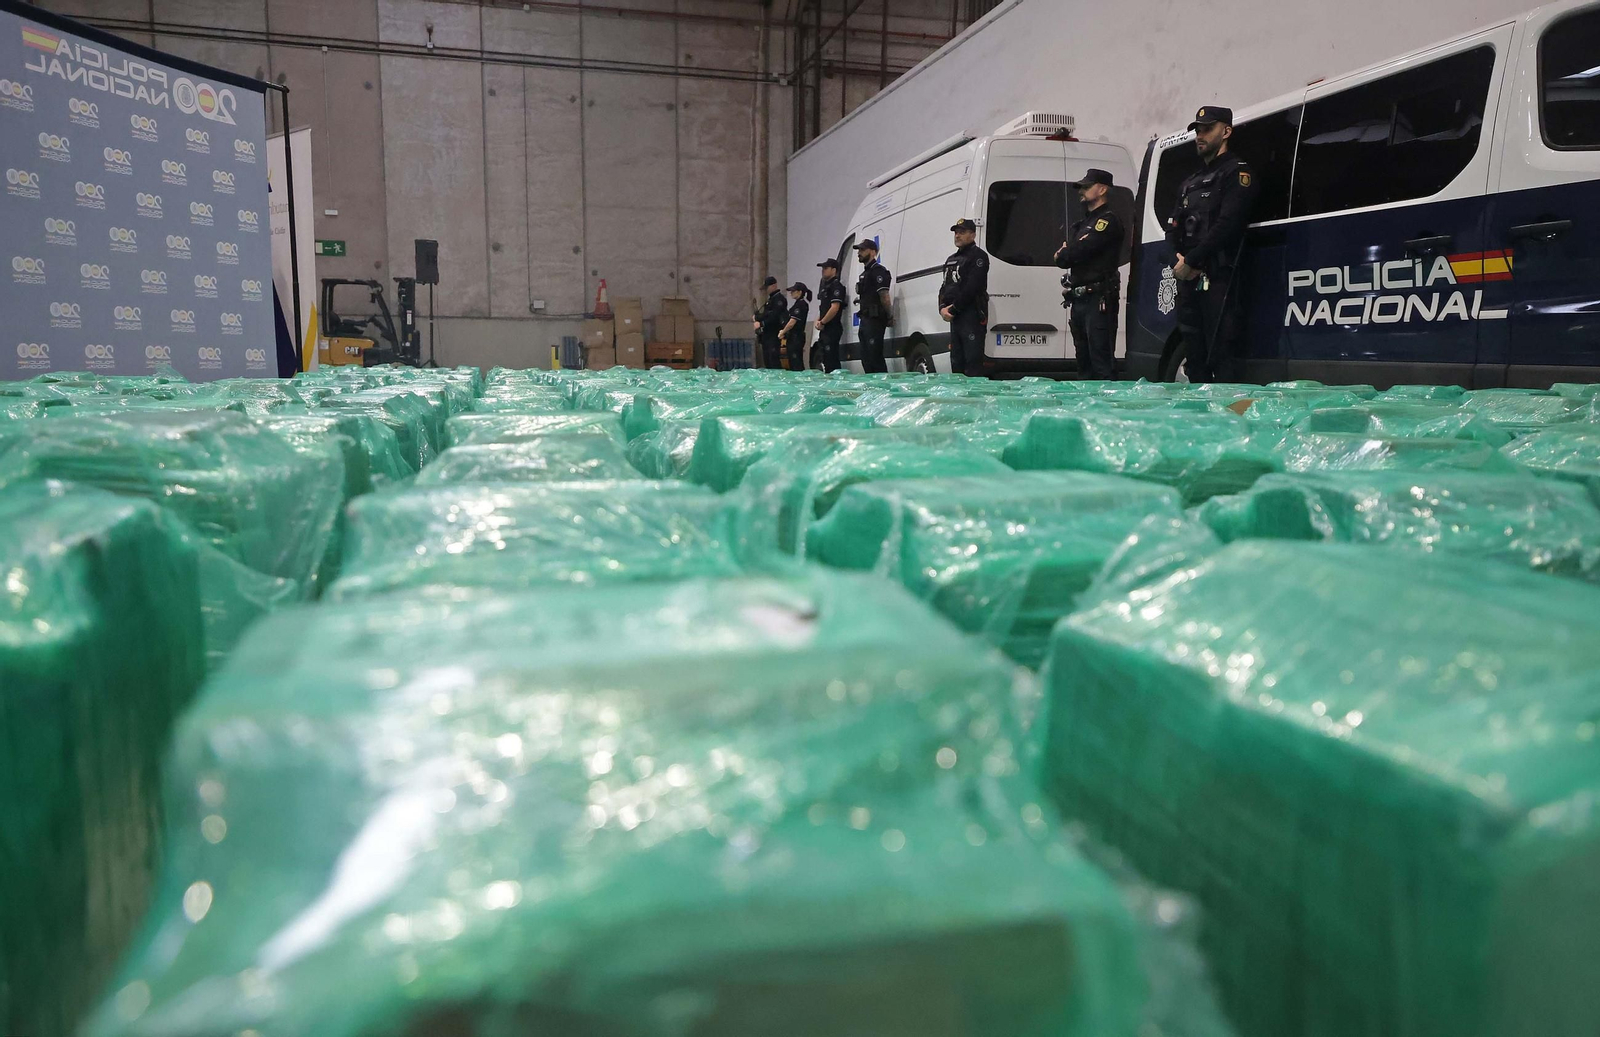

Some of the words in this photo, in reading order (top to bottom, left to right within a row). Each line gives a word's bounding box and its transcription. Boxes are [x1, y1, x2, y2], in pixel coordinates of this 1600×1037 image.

[1284, 290, 1508, 326] NACIONAL
[1003, 334, 1026, 345] 7256
[1030, 335, 1047, 344] MGW
[345, 346, 359, 355] CAT
